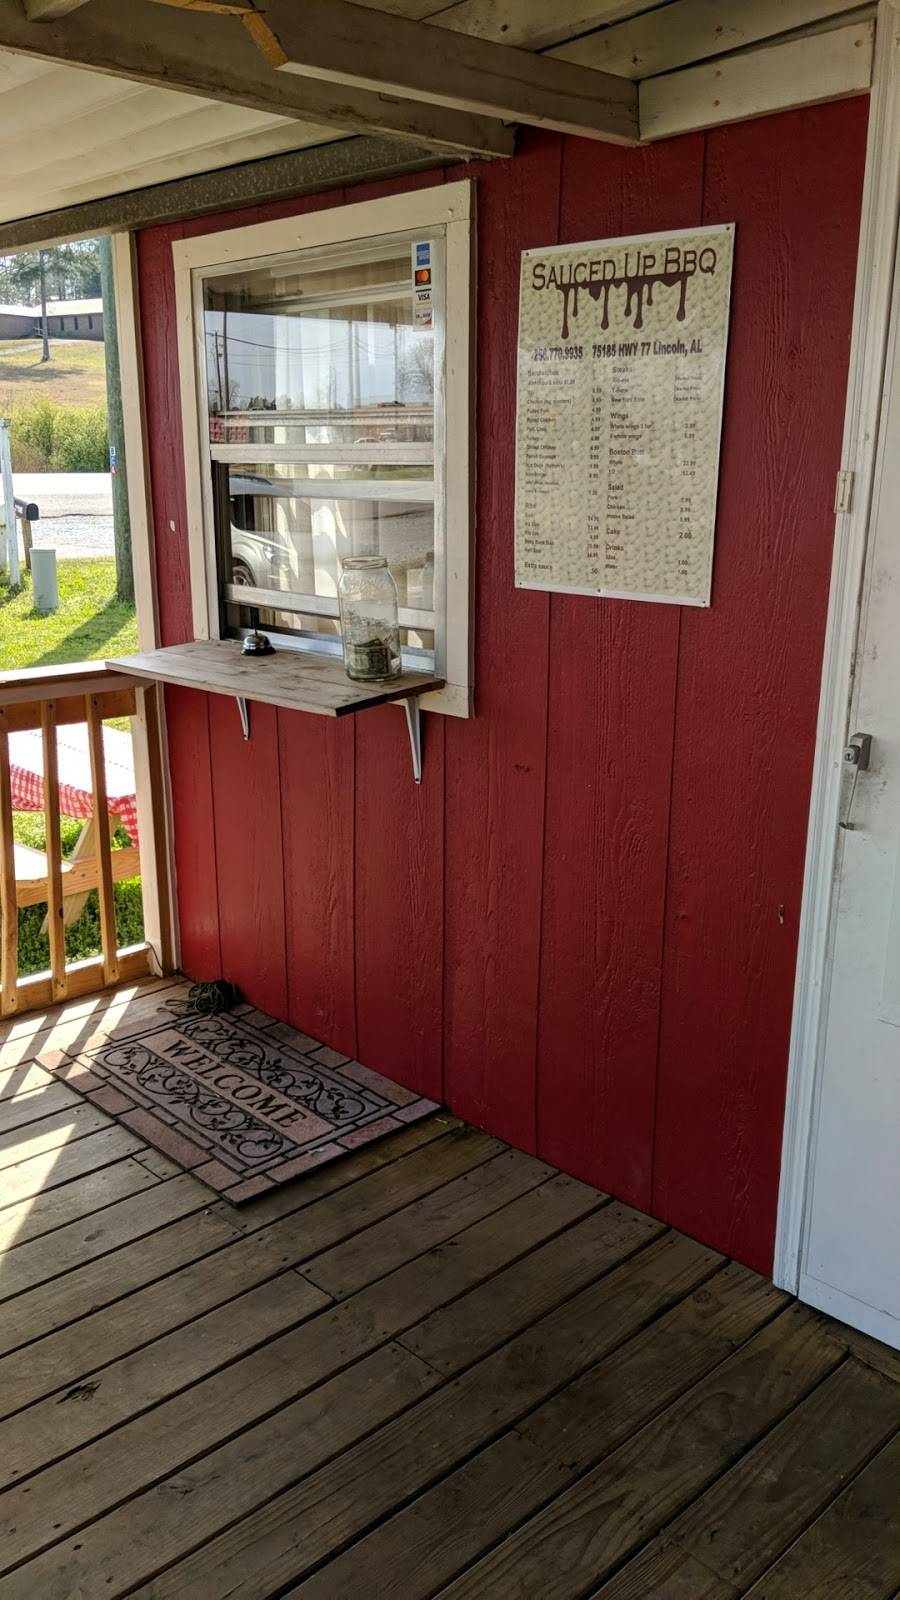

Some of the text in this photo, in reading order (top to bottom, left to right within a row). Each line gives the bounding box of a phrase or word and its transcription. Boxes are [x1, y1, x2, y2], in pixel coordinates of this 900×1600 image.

[618, 341, 639, 358] HWY
[640, 341, 652, 357] 77
[653, 338, 688, 358] Lincoln,
[690, 339, 703, 354] AL
[610, 412, 629, 421] Wings
[607, 483, 624, 491] Salad
[606, 527, 621, 535] Cake
[605, 543, 624, 551] Drinks
[162, 1039, 308, 1128] WELCOME
